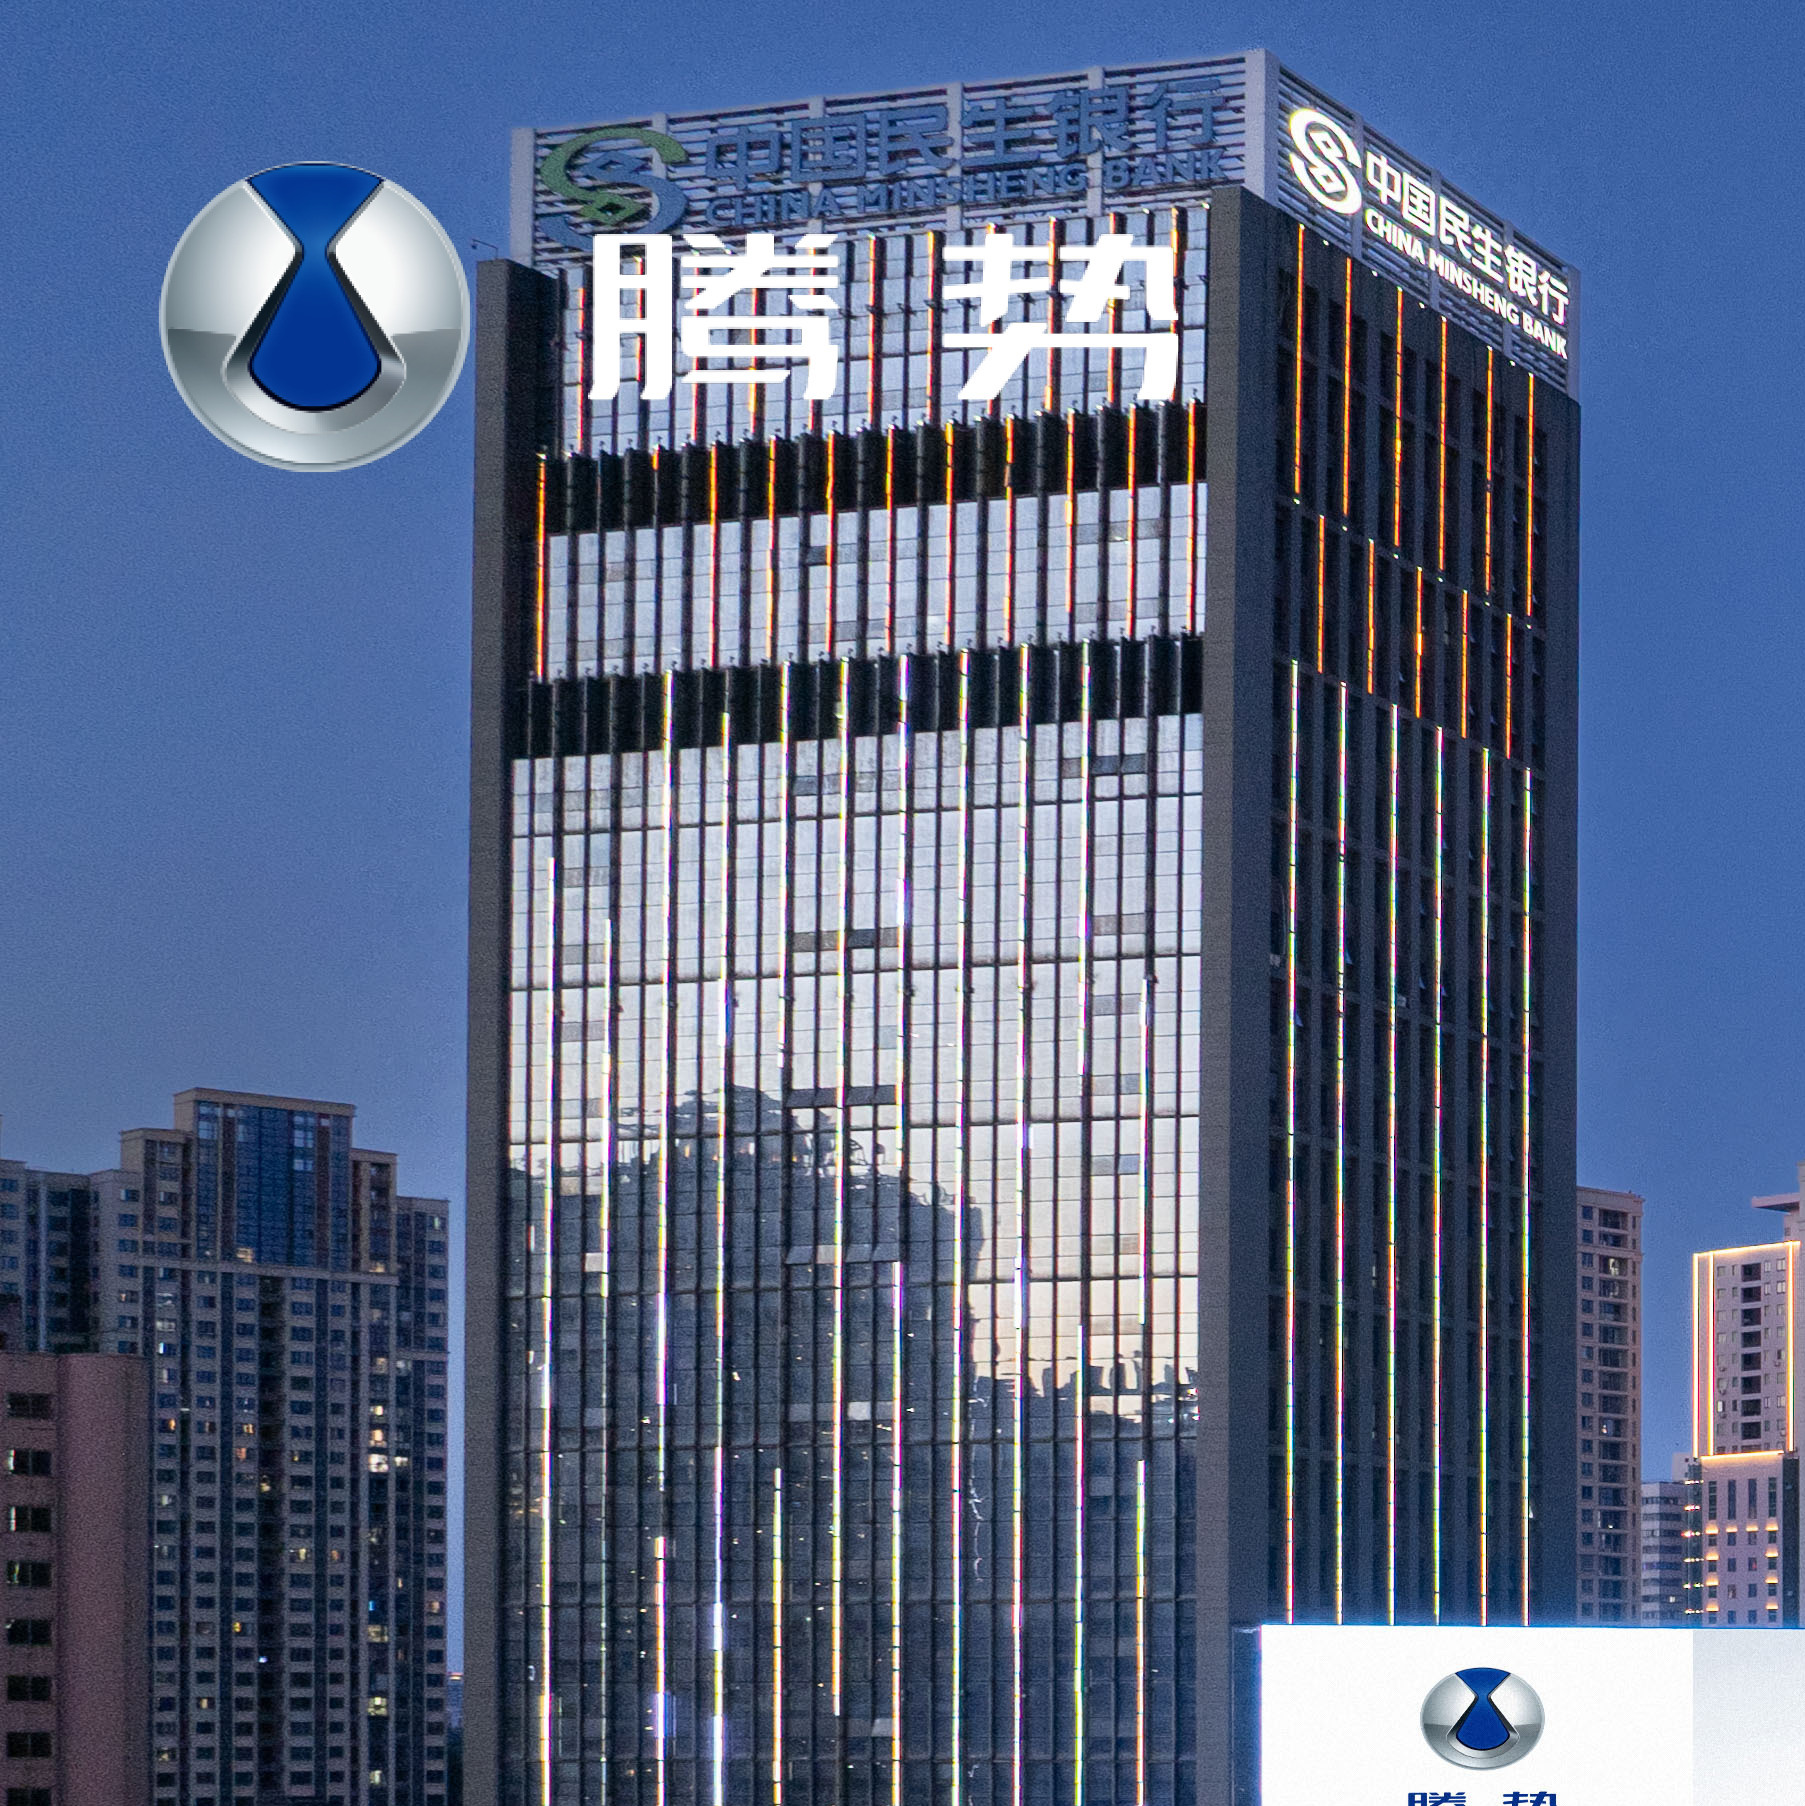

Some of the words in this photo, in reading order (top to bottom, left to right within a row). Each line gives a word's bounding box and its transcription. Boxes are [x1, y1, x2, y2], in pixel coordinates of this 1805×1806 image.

[705, 77, 1222, 190] 中国民生银行
[706, 187, 840, 229] CHINA
[857, 163, 1087, 214] MINSHENG
[1105, 149, 1228, 190] BANK
[1365, 151, 1569, 326] 中国民生银行
[1365, 207, 1425, 265] CHINA
[1428, 247, 1520, 325] MINSHENG
[1522, 312, 1568, 359] BANK
